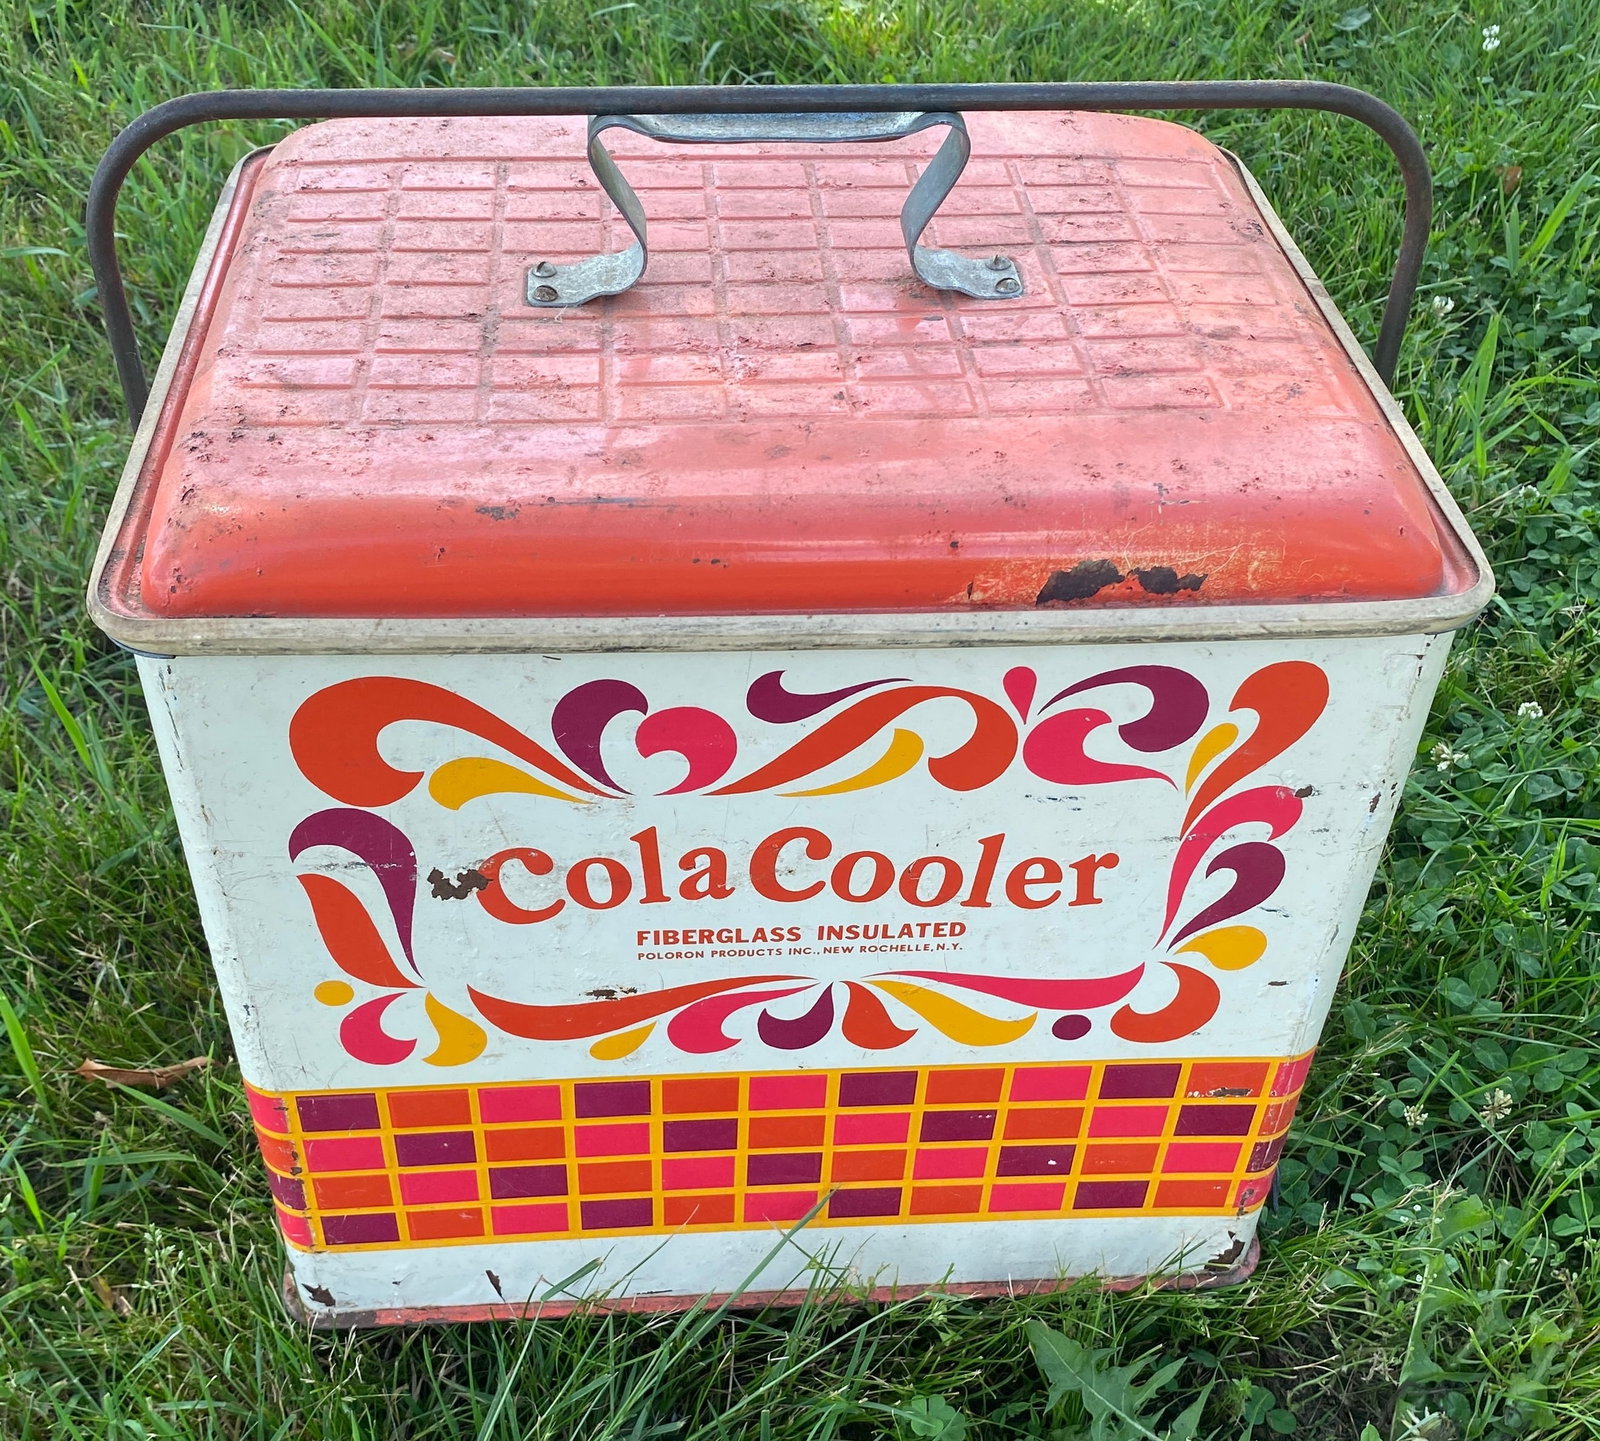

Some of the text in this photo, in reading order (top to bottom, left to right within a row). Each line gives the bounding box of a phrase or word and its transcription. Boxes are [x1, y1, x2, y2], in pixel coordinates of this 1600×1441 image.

[636, 921, 967, 946] FIBERGLASS INSULATED
[637, 951, 705, 961] POLORON
[711, 948, 783, 958] PRODUCTS
[823, 946, 853, 954] NEW
[936, 942, 963, 951] N.Y.
